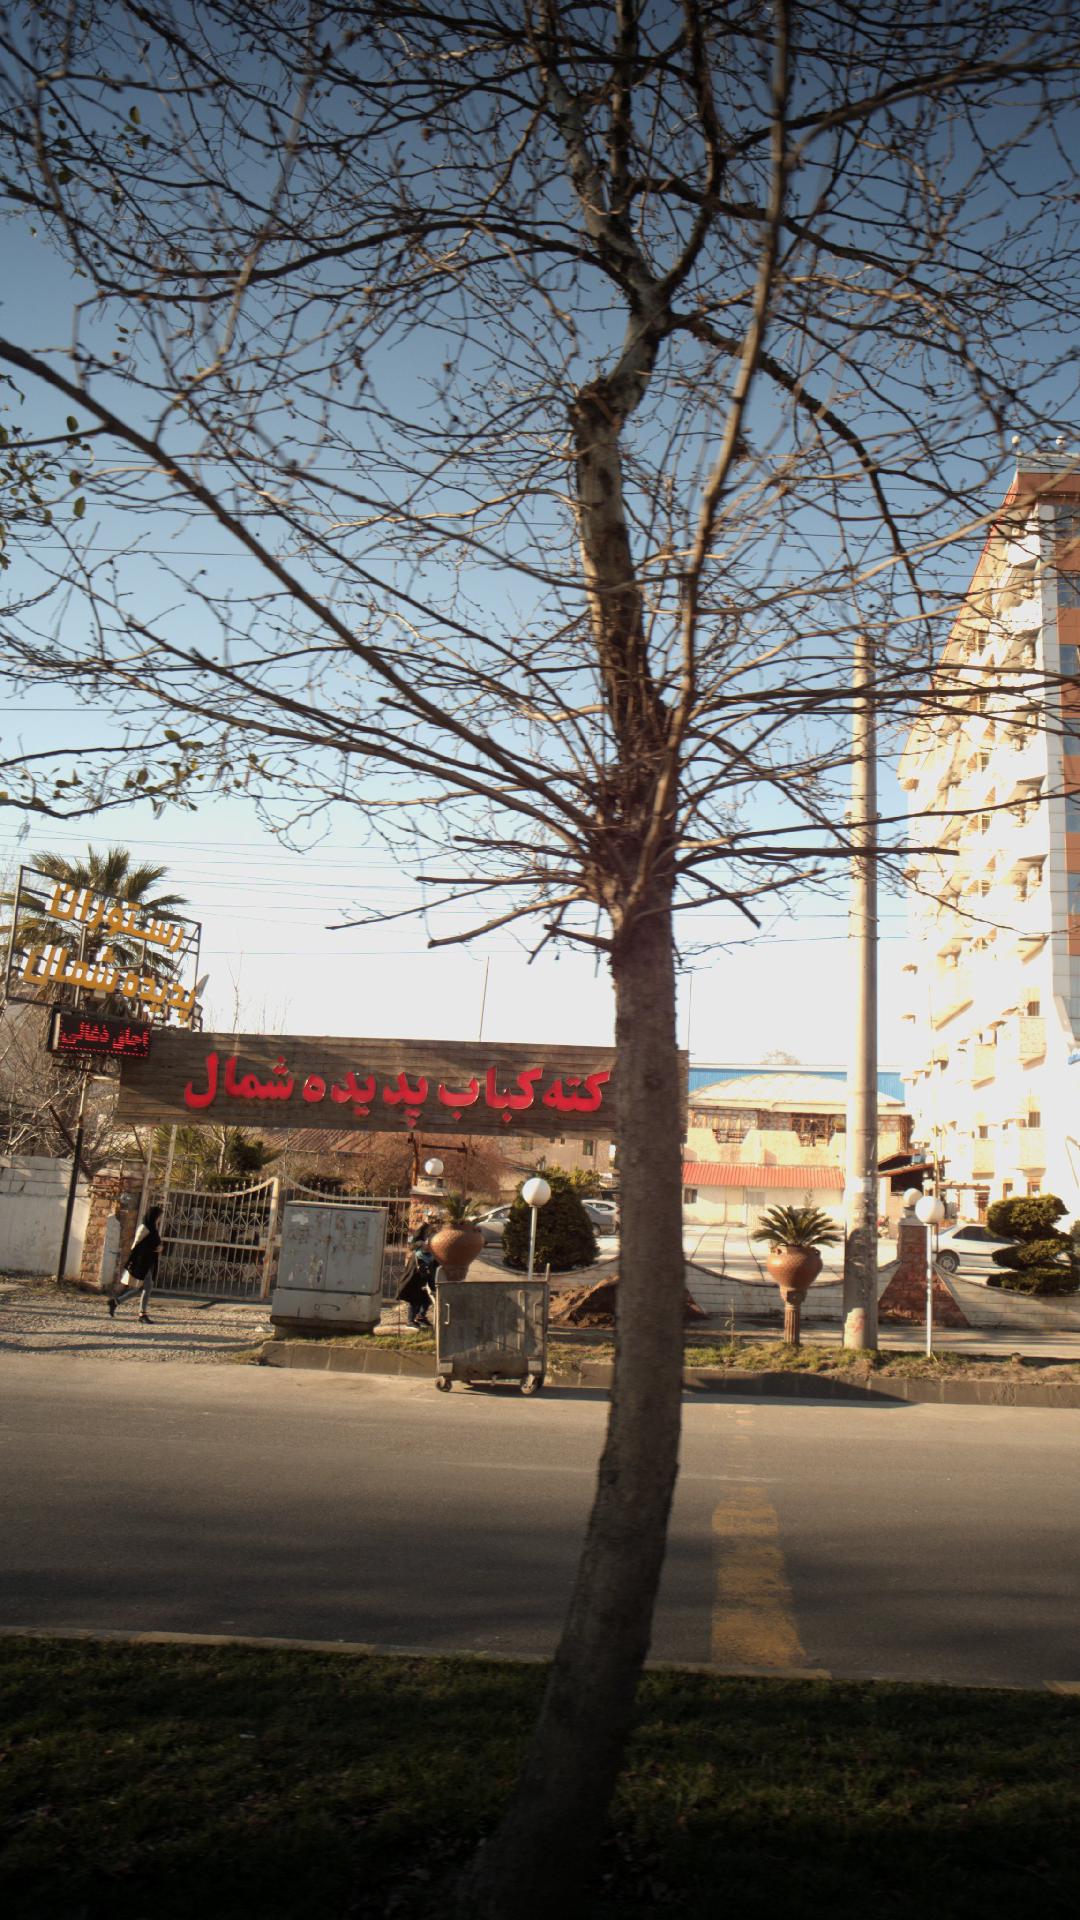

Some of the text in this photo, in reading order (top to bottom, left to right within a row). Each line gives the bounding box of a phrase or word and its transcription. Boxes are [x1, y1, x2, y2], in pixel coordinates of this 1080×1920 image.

[47, 883, 184, 952] رستوران
[21, 944, 196, 1025] پدیده شمال
[184, 1051, 611, 1128] کته کباب پدیده شمال
